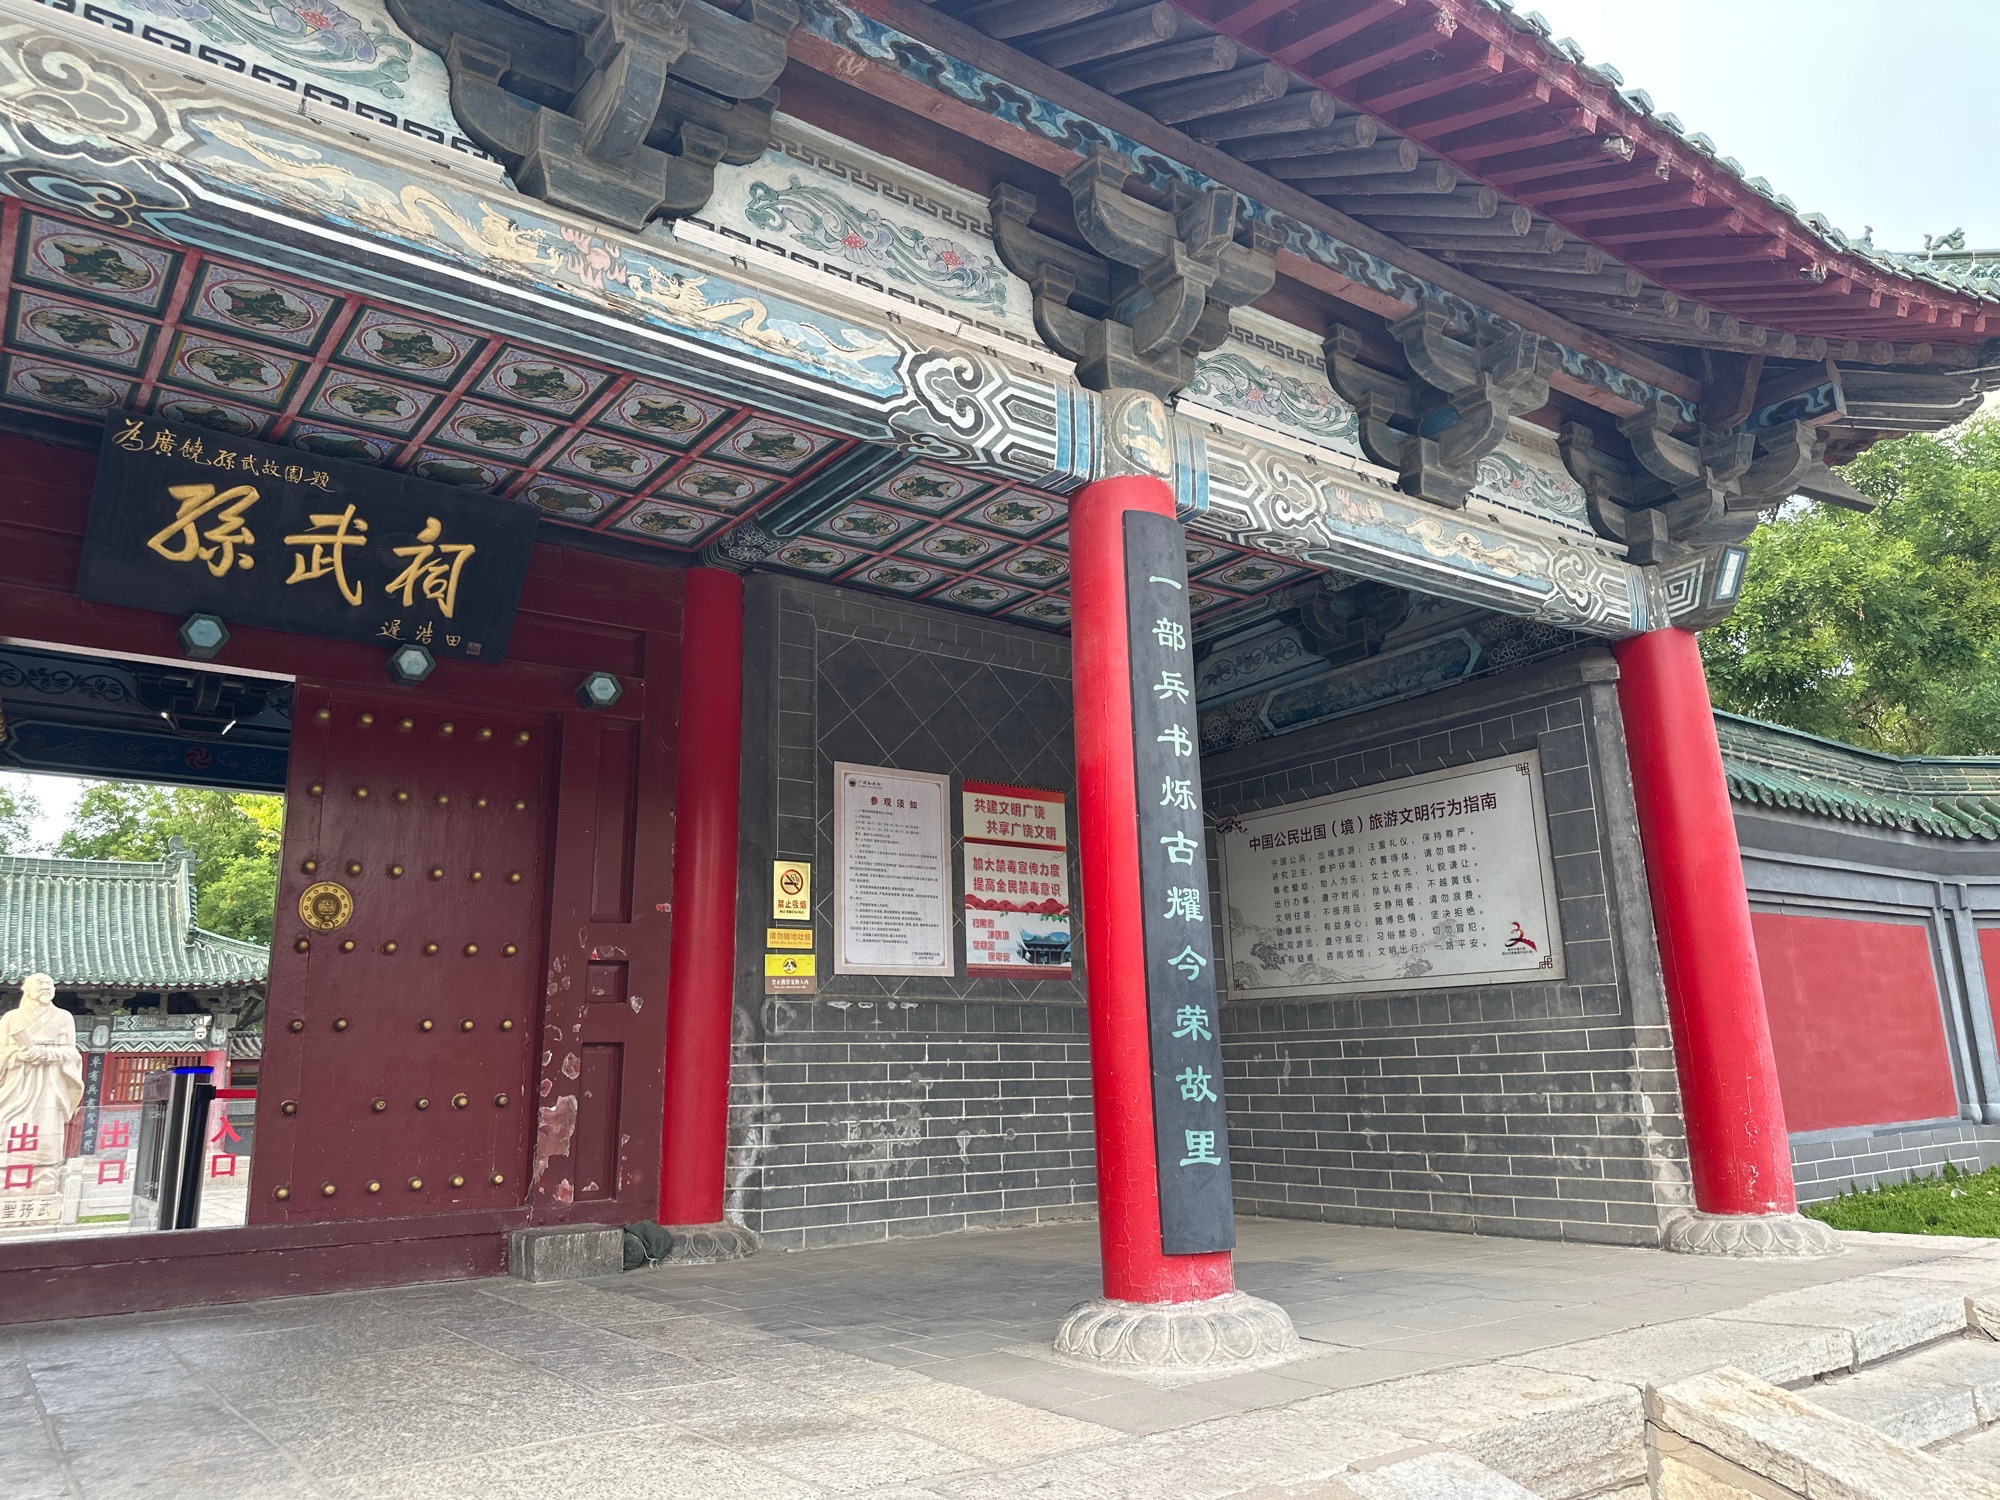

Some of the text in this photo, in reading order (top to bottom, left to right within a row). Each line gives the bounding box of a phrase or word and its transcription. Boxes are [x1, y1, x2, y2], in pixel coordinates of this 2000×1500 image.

[147, 483, 475, 618] 孫武祠
[870, 796, 917, 809] 参观须知
[974, 798, 1045, 819] 共建文明广饶
[987, 819, 1056, 840] 共享广饶文明
[1249, 792, 1497, 852] 中国公民出国（境）旅游文明行为指南
[973, 857, 1060, 877] 加大禁毒宣传力度
[973, 877, 1061, 897] 提高全民禁毒意识
[777, 899, 807, 909] 禁止吸烟
[770, 932, 811, 941] 请勿随地吐痰
[4, 1122, 39, 1190] 出口
[97, 1119, 130, 1185] 出口
[210, 1116, 242, 1178] 入口
